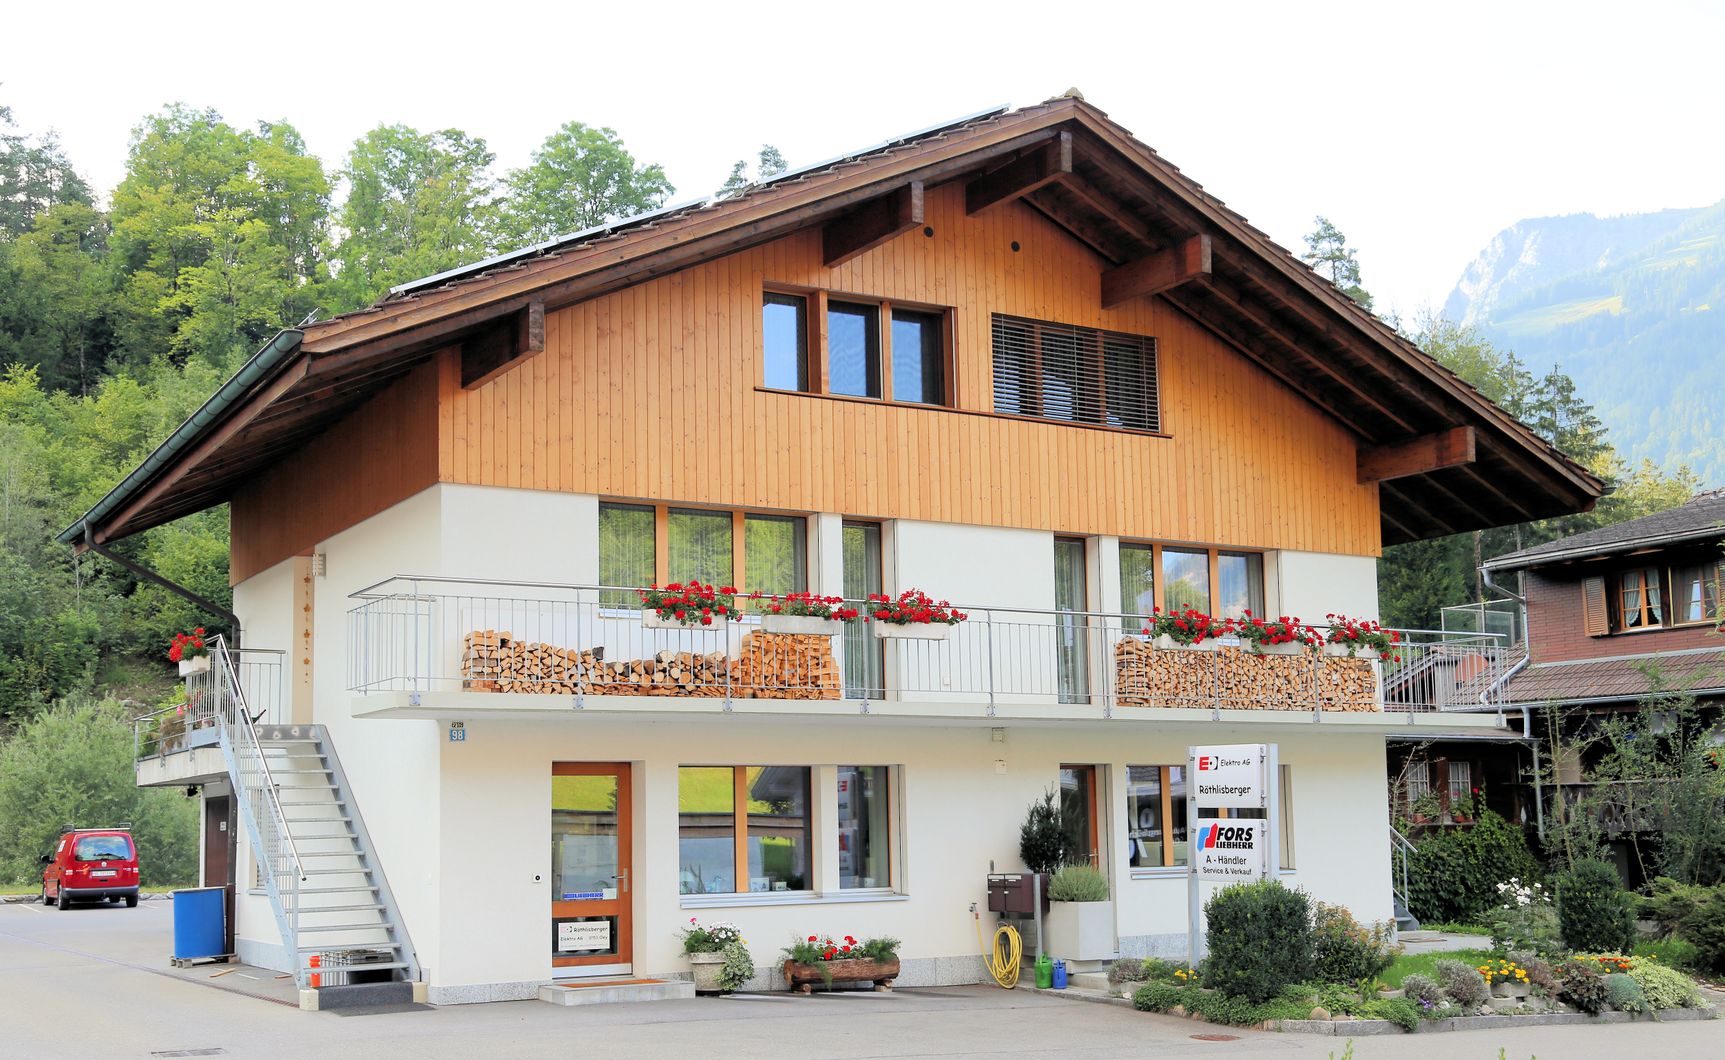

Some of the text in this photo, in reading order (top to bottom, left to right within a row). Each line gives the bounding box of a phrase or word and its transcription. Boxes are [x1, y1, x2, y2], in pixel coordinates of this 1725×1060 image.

[452, 730, 463, 740] 98
[1220, 758, 1240, 767] Elektro
[1241, 758, 1251, 766] AG
[1199, 784, 1252, 797] Röthlisberger
[1217, 827, 1254, 841] FORS
[1216, 841, 1253, 850] LIEBHERR
[1206, 855, 1212, 864] A
[1217, 855, 1247, 865] Händler
[1224, 867, 1230, 875] &
[1230, 867, 1252, 876] Verkauf
